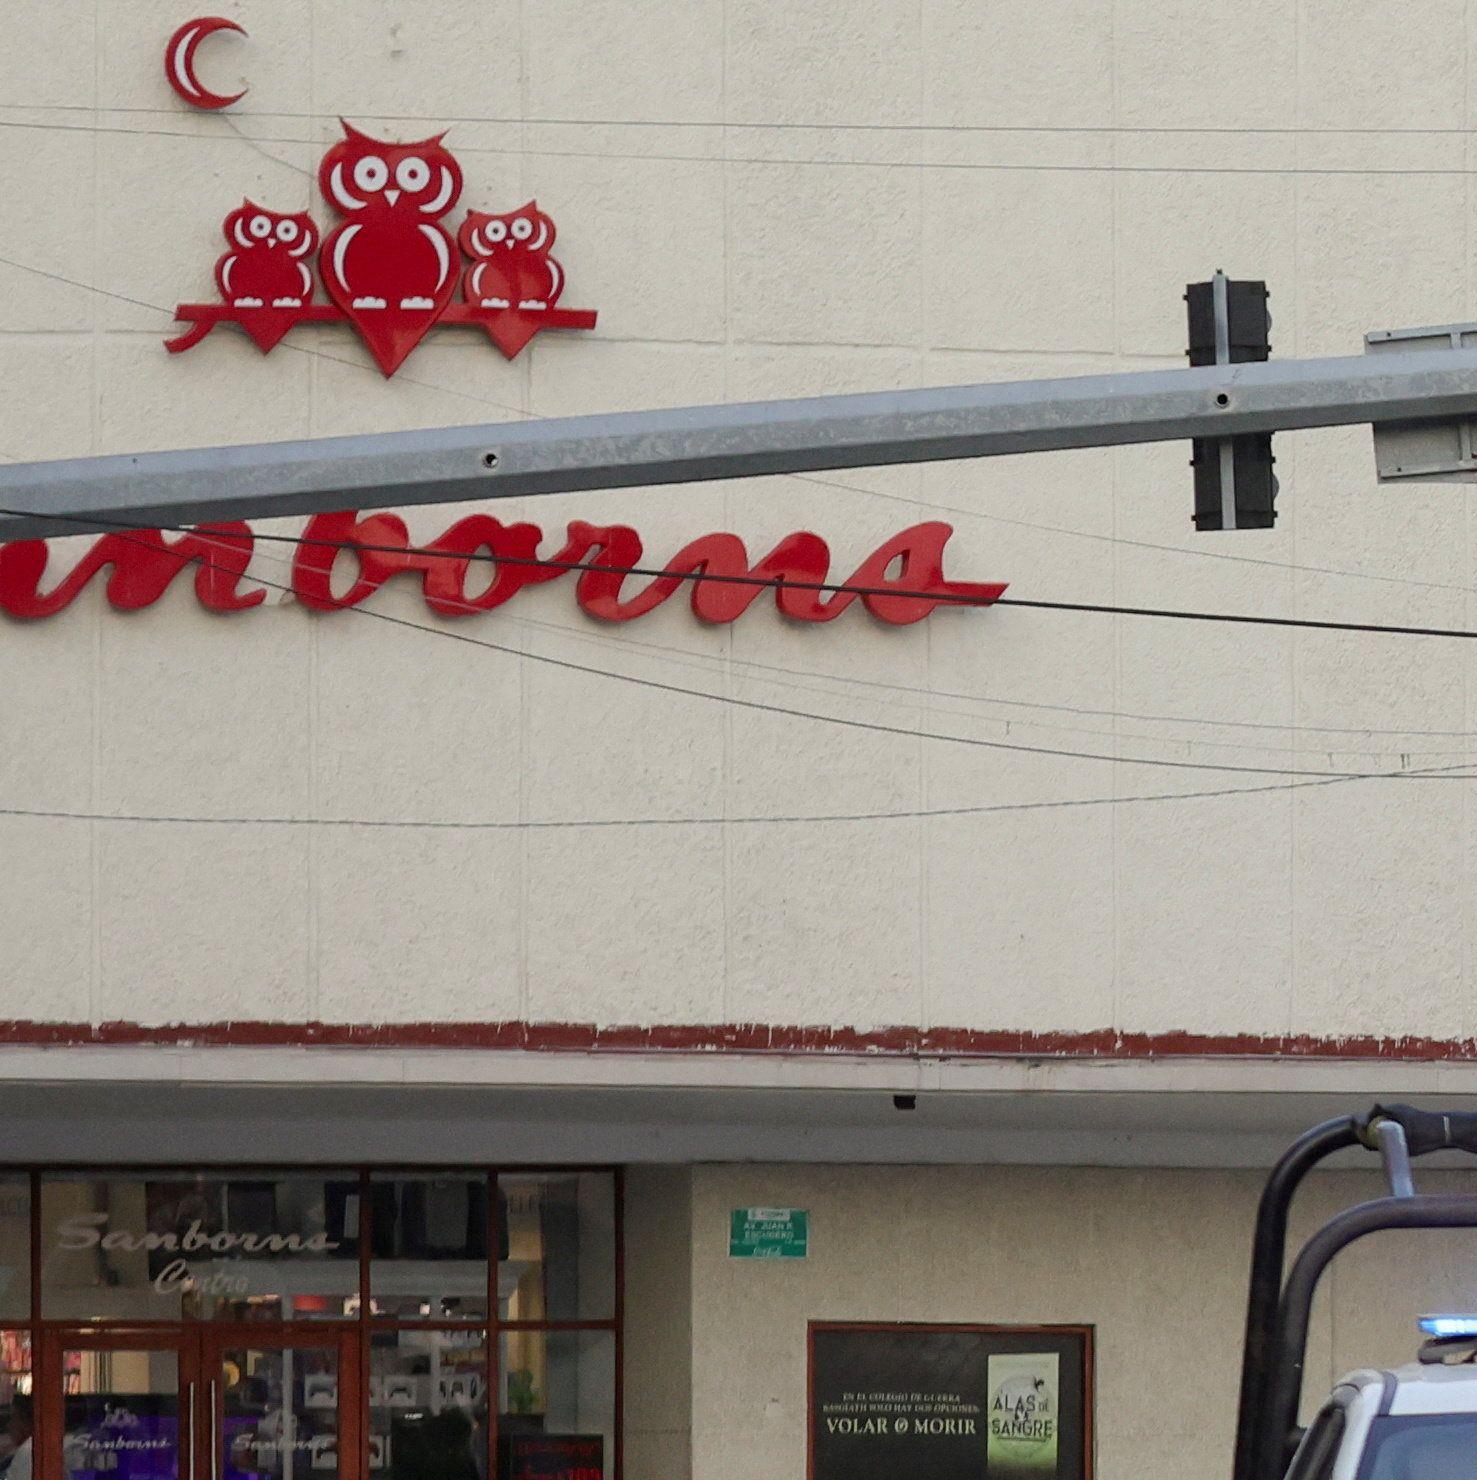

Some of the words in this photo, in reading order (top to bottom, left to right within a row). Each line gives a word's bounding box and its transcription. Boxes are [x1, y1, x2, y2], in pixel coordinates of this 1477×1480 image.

[57, 1212, 341, 1252] Sanborns
[993, 1394, 1036, 1413] ALAS
[826, 1417, 888, 1435] VOLAR
[914, 1418, 976, 1435] MORIR
[991, 1417, 1053, 1440] SANGRE
[73, 1433, 172, 1450] Sanborns
